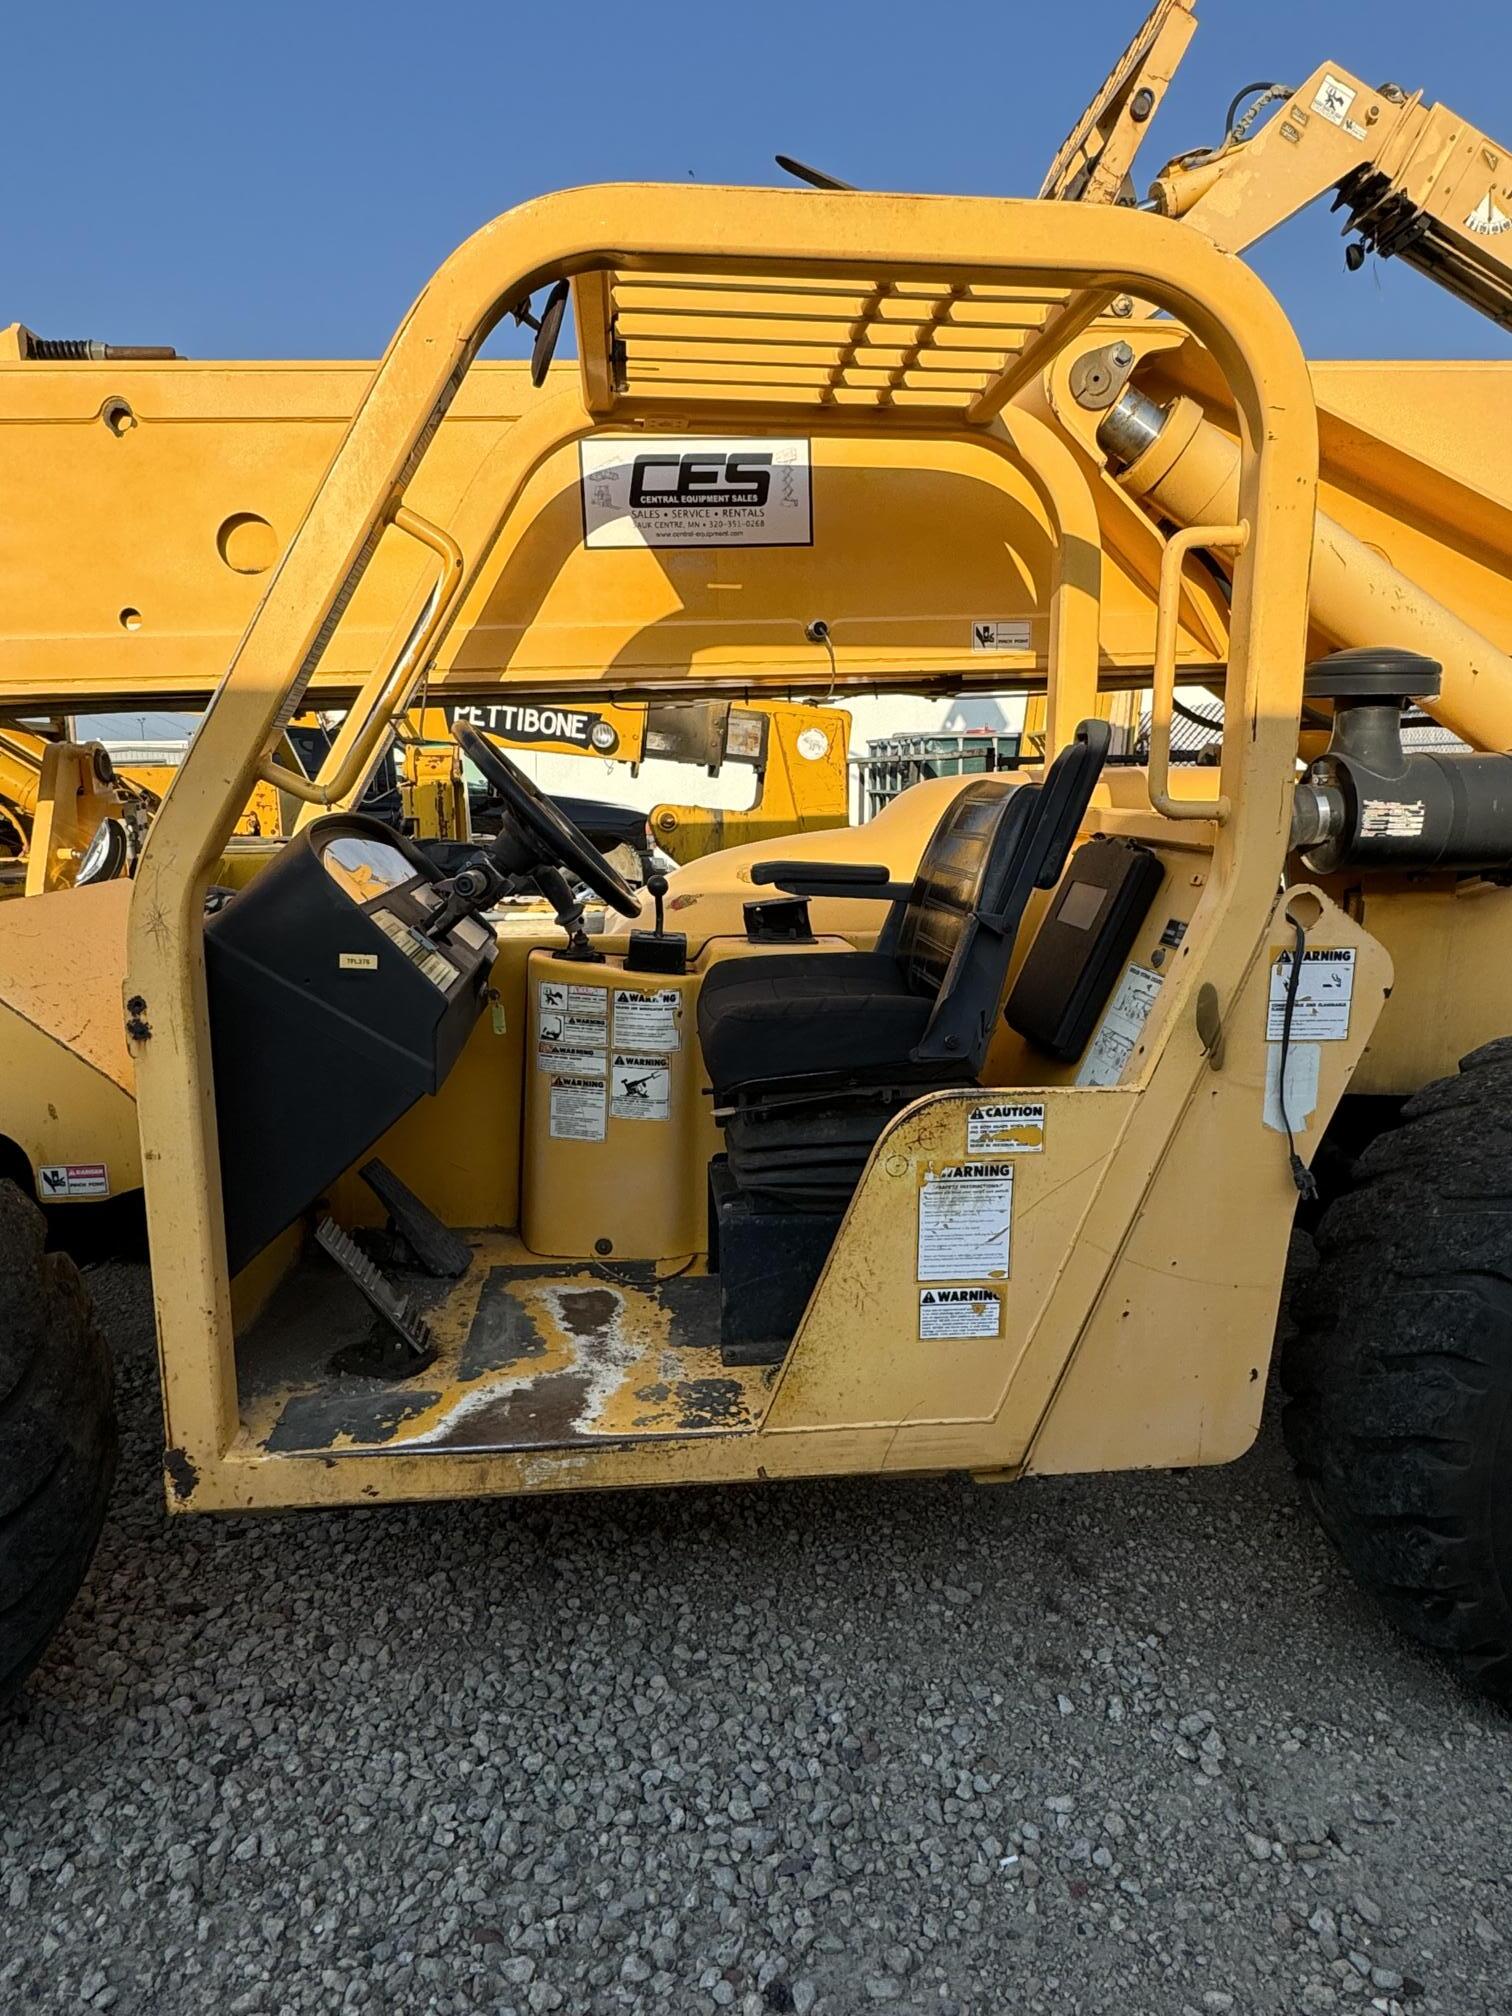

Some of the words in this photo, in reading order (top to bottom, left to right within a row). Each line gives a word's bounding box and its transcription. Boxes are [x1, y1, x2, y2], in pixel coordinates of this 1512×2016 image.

[629, 453, 773, 508] CES
[640, 495, 679, 504] CENTRAL
[681, 494, 730, 504] EQUIPMENT
[731, 494, 758, 503] SALES
[631, 510, 660, 518] SALES
[672, 509, 711, 518] SERVICE
[722, 508, 765, 518] RENTALS
[654, 520, 685, 529] CENTRE,
[687, 520, 700, 528] MN
[453, 705, 588, 739] PETTIBONE
[1294, 951, 1351, 961] ARNING
[575, 1017, 605, 1026] WARNING
[558, 1047, 594, 1056] WARNING
[626, 1057, 667, 1066] WARNING
[563, 1079, 604, 1088] WARNING
[986, 1106, 1043, 1117] CAUTION
